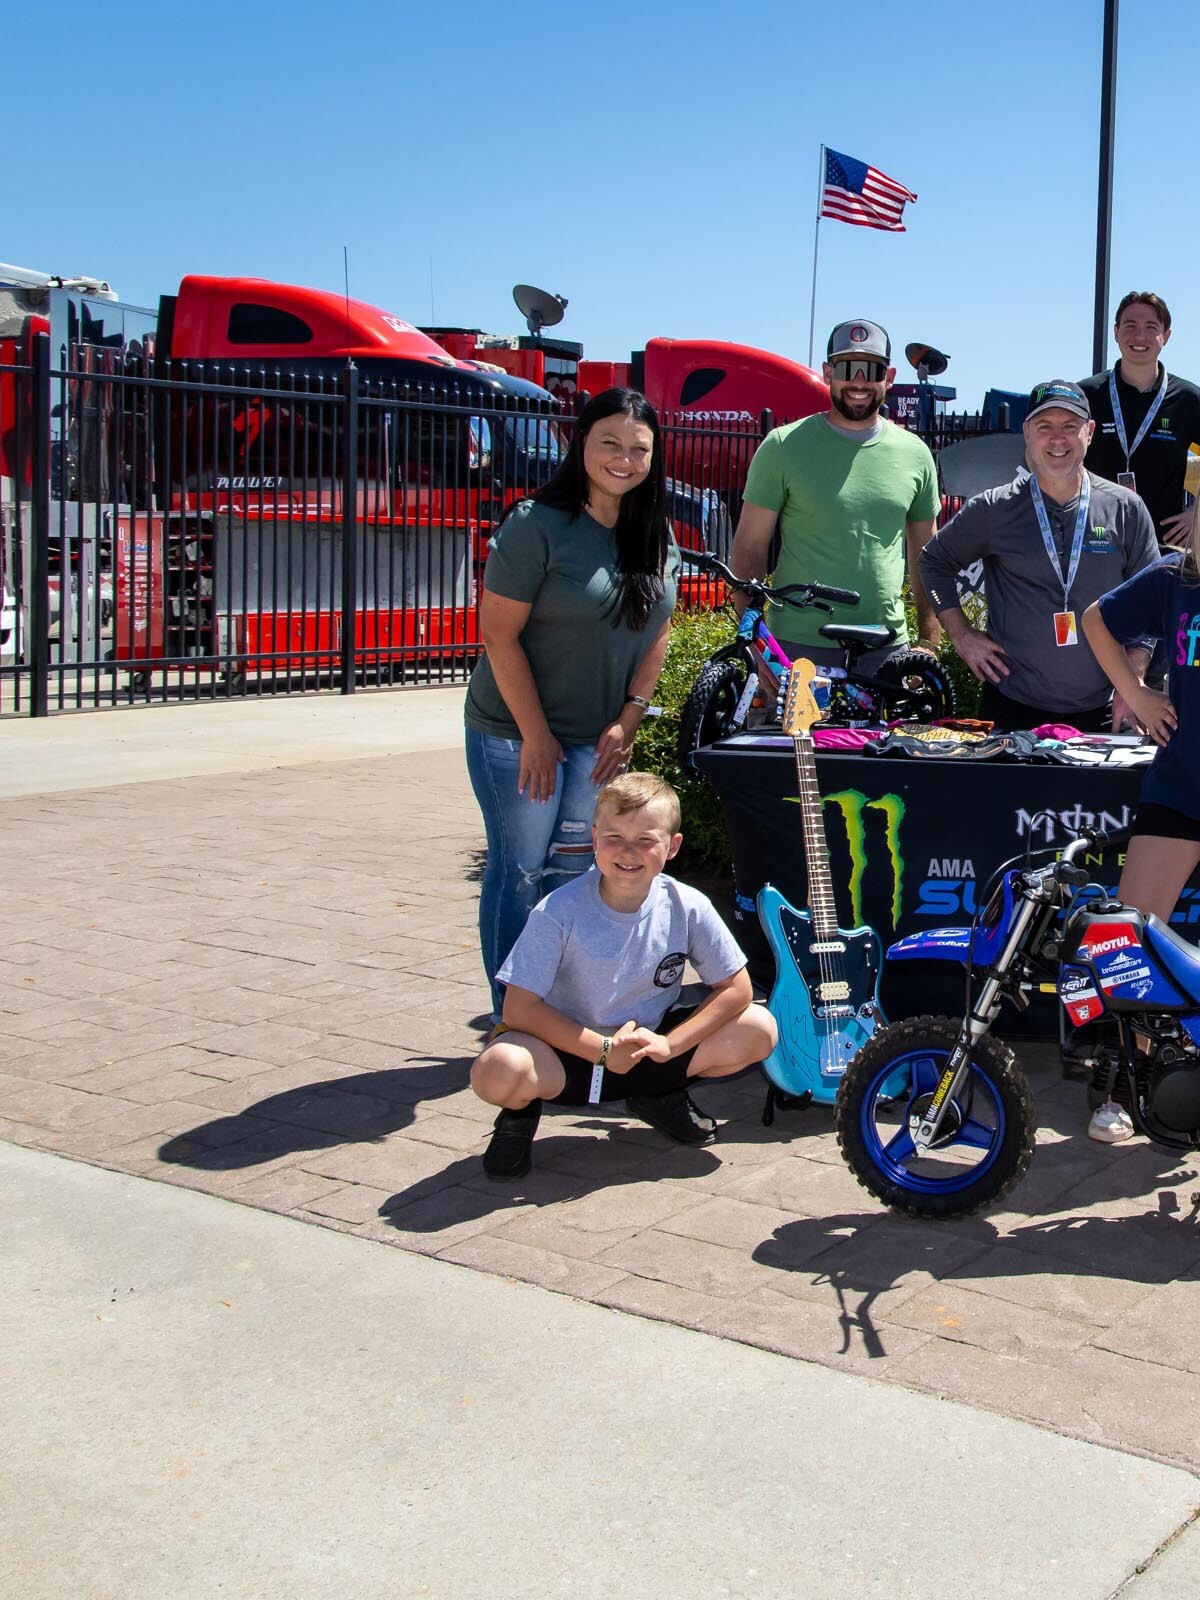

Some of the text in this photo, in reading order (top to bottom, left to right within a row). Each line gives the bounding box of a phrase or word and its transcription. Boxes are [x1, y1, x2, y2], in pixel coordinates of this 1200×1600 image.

[897, 397, 920, 405] READY
[680, 411, 753, 421] HONDA
[927, 858, 976, 878] AMA
[1092, 936, 1130, 954] MOTUL
[1119, 970, 1140, 981] YAMAHA
